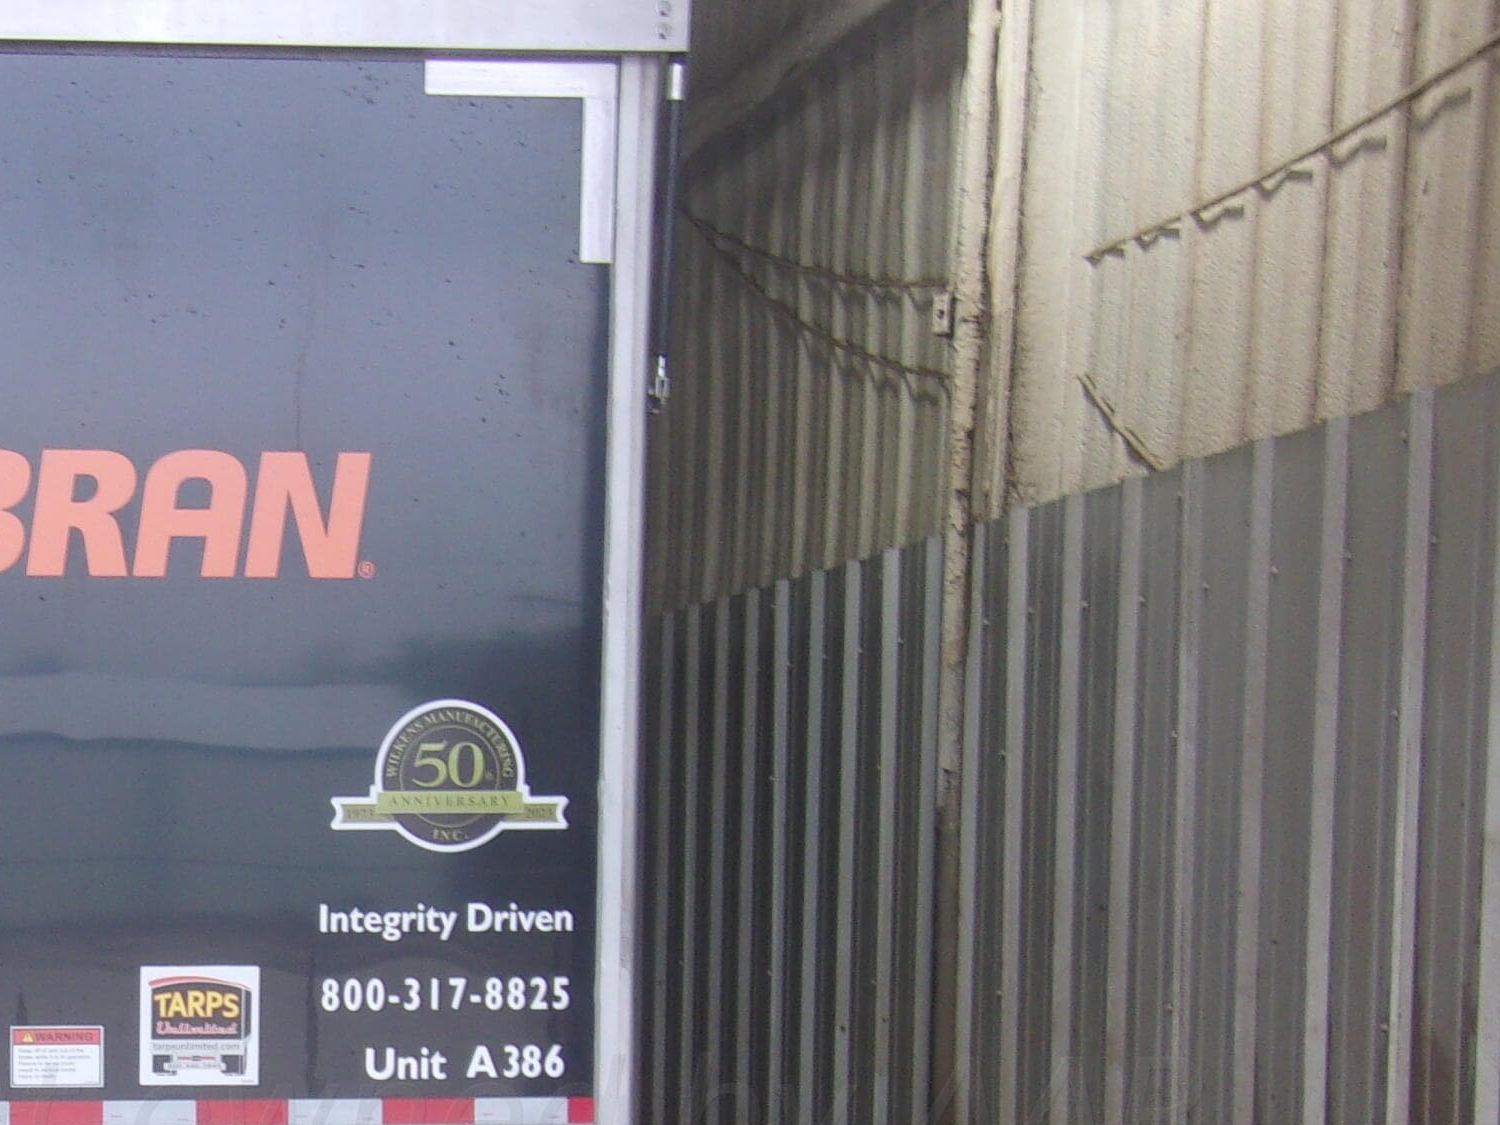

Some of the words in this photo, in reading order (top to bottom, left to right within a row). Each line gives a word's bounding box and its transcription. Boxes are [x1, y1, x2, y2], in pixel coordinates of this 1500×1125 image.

[386, 721, 425, 778] WILKENS
[425, 709, 514, 778] MANUFACTURING
[389, 796, 510, 808] ANNIVERSARY
[432, 829, 468, 842] INC.
[319, 902, 458, 941] Integrity
[467, 902, 574, 933] Driven
[153, 989, 240, 1019] TARPS
[321, 976, 571, 1012] 800-317-8825
[34, 1031, 94, 1043] WARNING
[364, 1047, 448, 1081] Unit
[466, 1044, 566, 1080] A386
